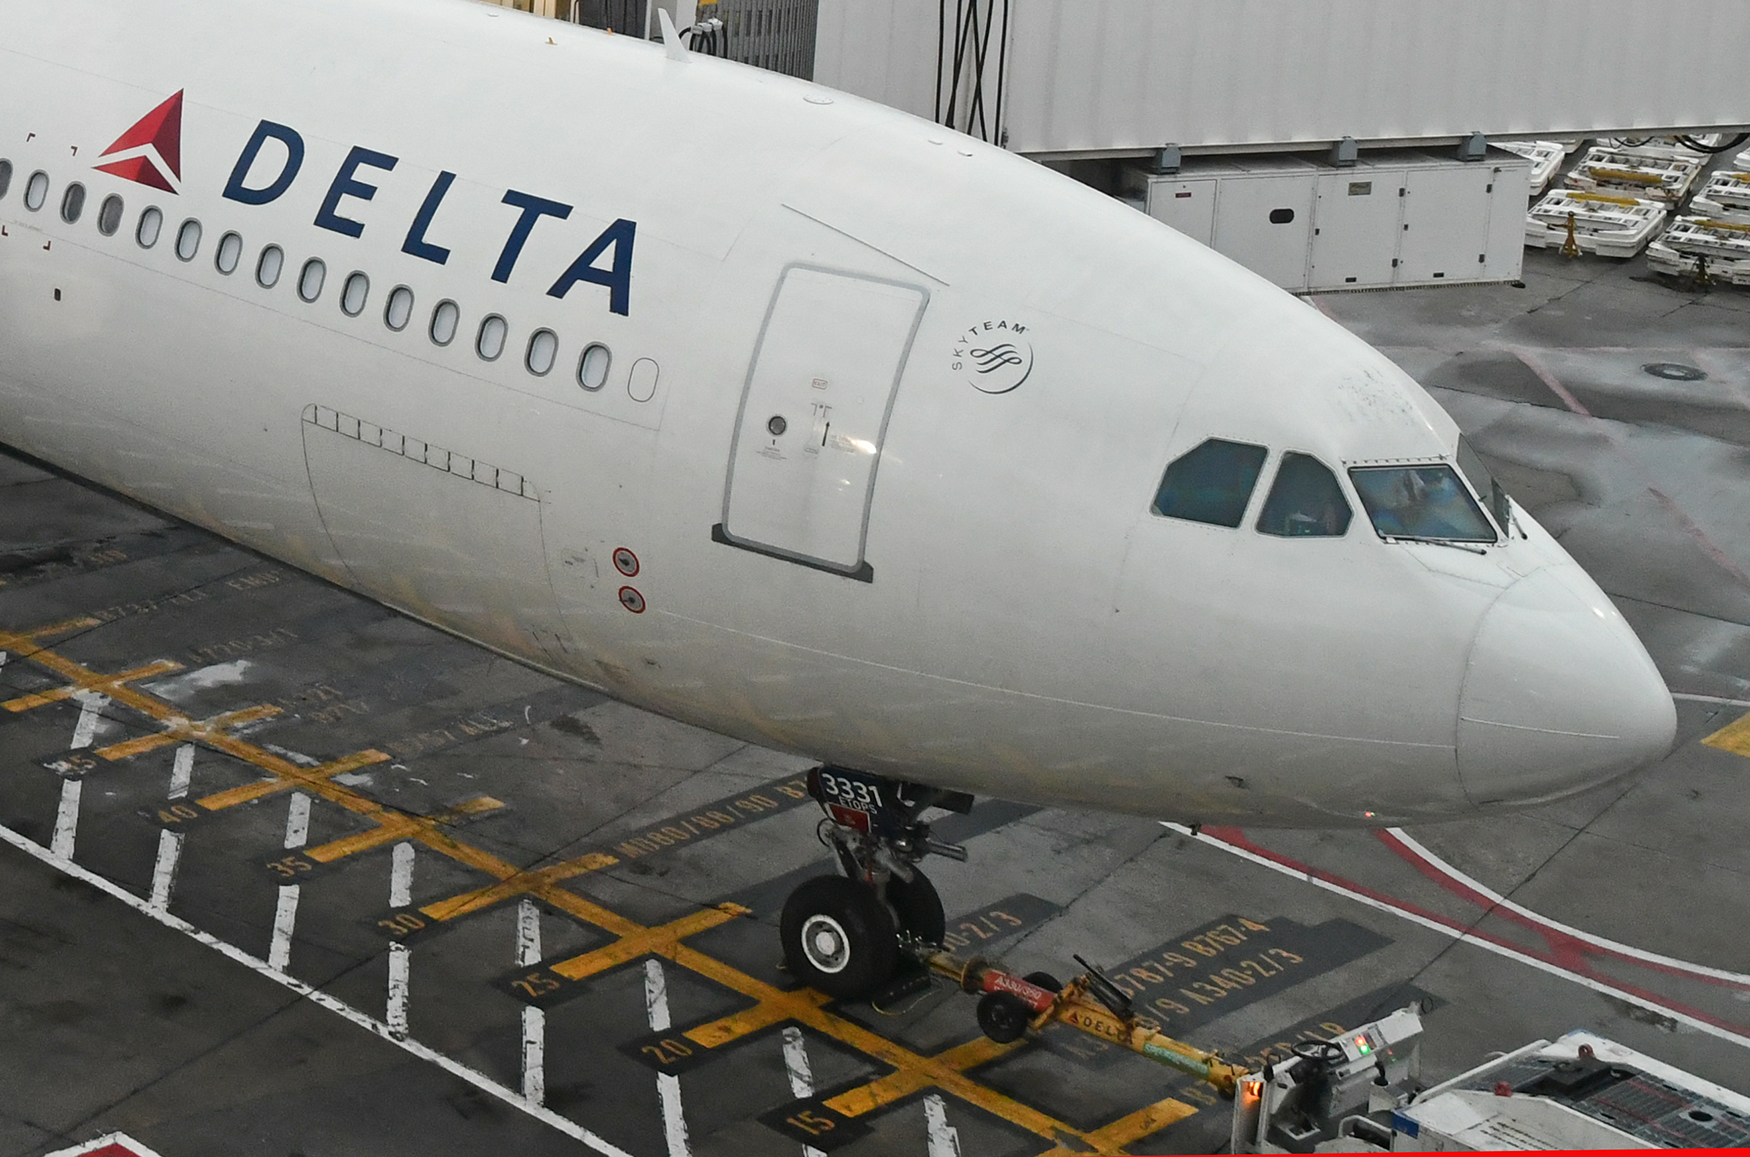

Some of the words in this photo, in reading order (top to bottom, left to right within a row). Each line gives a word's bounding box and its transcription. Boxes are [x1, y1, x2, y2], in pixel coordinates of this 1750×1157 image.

[221, 118, 638, 318] DELTA
[821, 772, 884, 808] 3331
[157, 804, 199, 825] 40
[838, 795, 878, 815] ETOPS
[265, 856, 313, 877] 35
[377, 912, 426, 936] 30
[510, 971, 561, 998] 25
[1180, 947, 1304, 1006] A340-2/3
[640, 1037, 694, 1065] 20
[785, 1109, 837, 1136] 15
